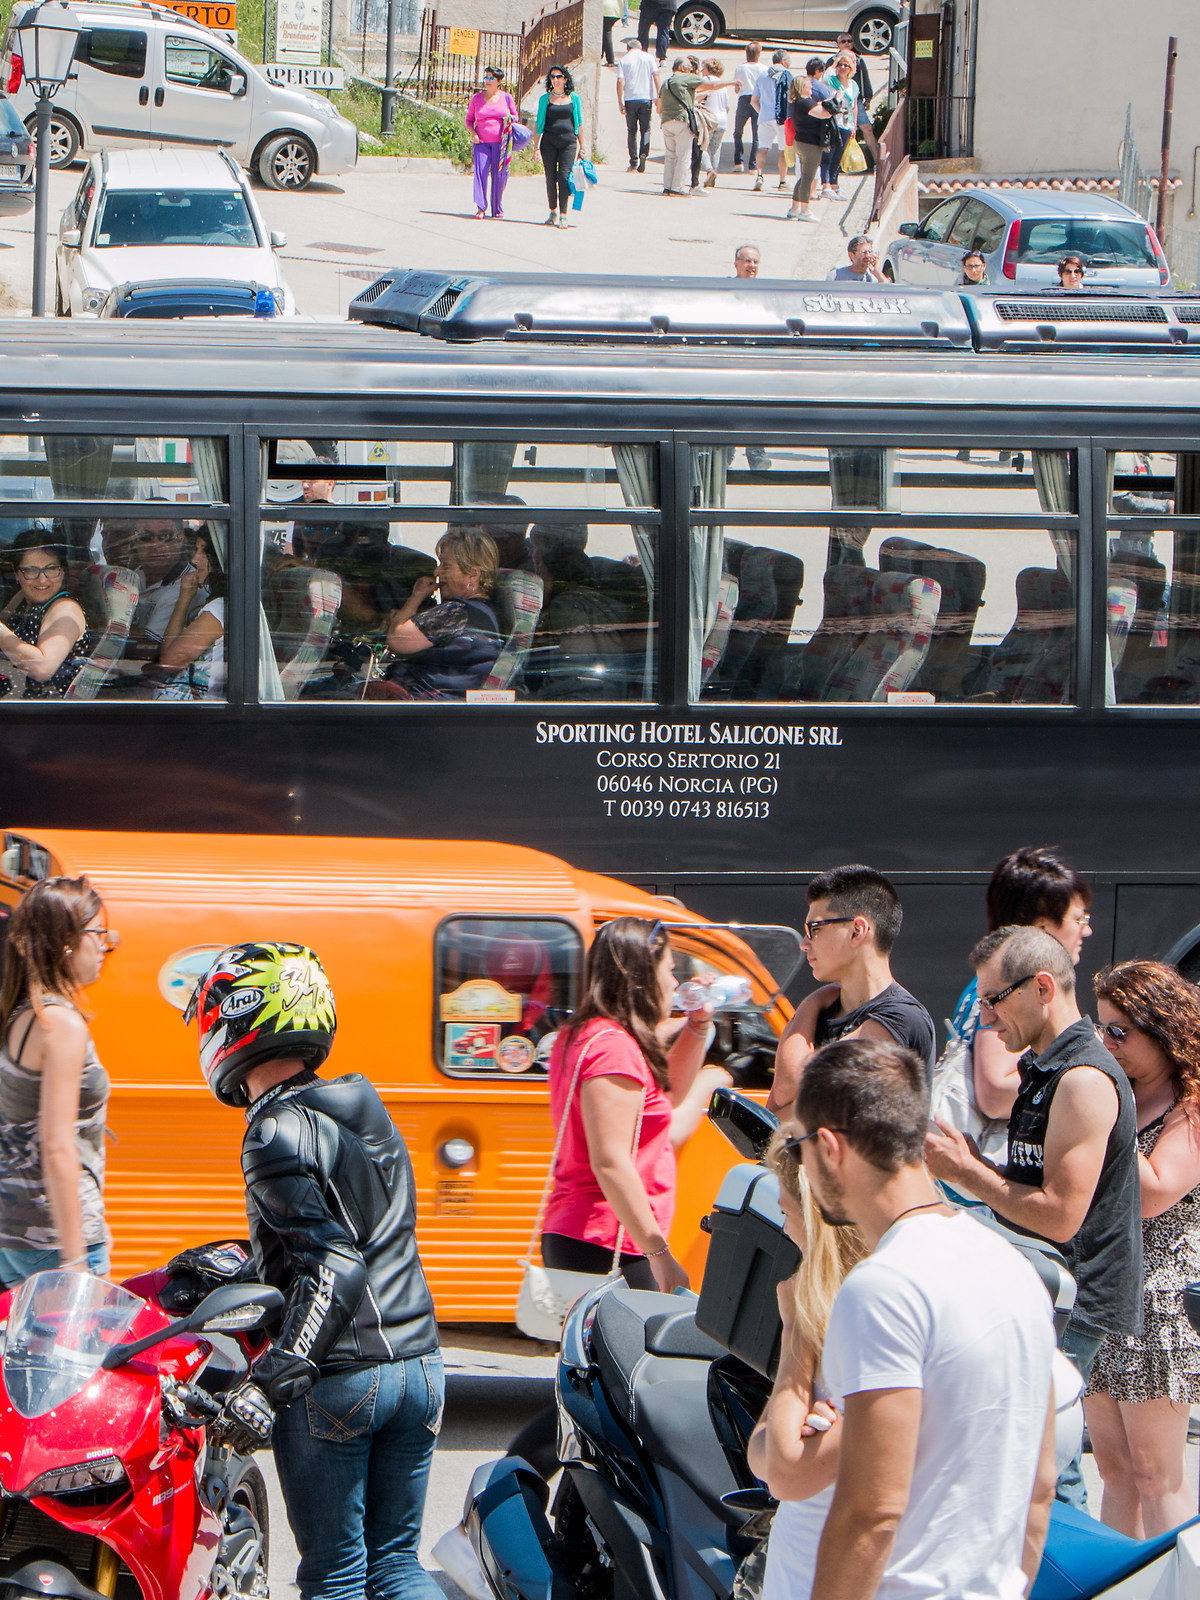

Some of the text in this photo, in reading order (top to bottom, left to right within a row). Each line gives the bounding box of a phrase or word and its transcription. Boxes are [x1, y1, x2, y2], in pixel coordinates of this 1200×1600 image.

[536, 721, 843, 746] SPORTING HOTEL SALICONE SRL
[596, 750, 781, 770] CORSO SERTORIO 21
[597, 774, 779, 796] 06046 NORCIA (PG)
[603, 800, 771, 819] T 0039 0743 816513
[223, 990, 258, 1016] Arai
[86, 1447, 114, 1459] DUCATI
